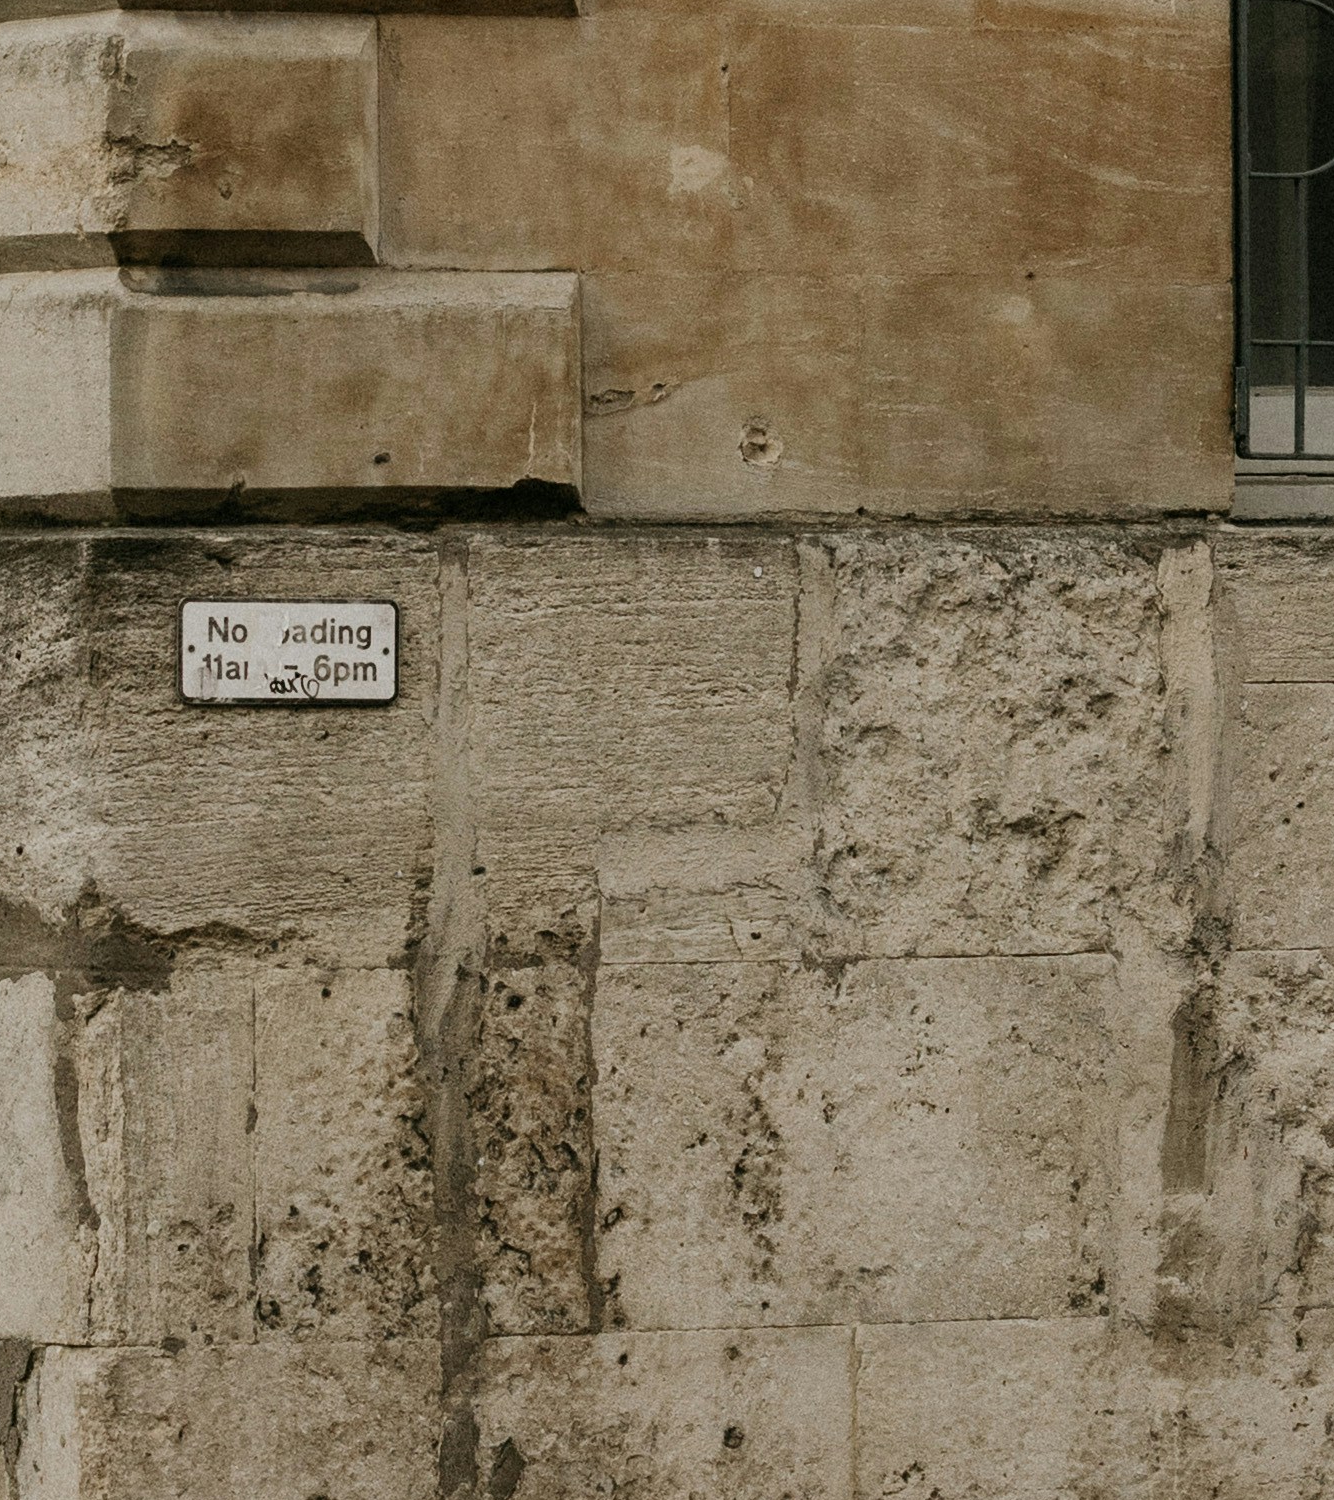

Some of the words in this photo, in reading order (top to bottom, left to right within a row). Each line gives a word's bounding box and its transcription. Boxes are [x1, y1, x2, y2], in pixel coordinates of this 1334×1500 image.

[208, 616, 248, 644] No
[281, 618, 372, 651] ading
[313, 654, 378, 687] 6pm
